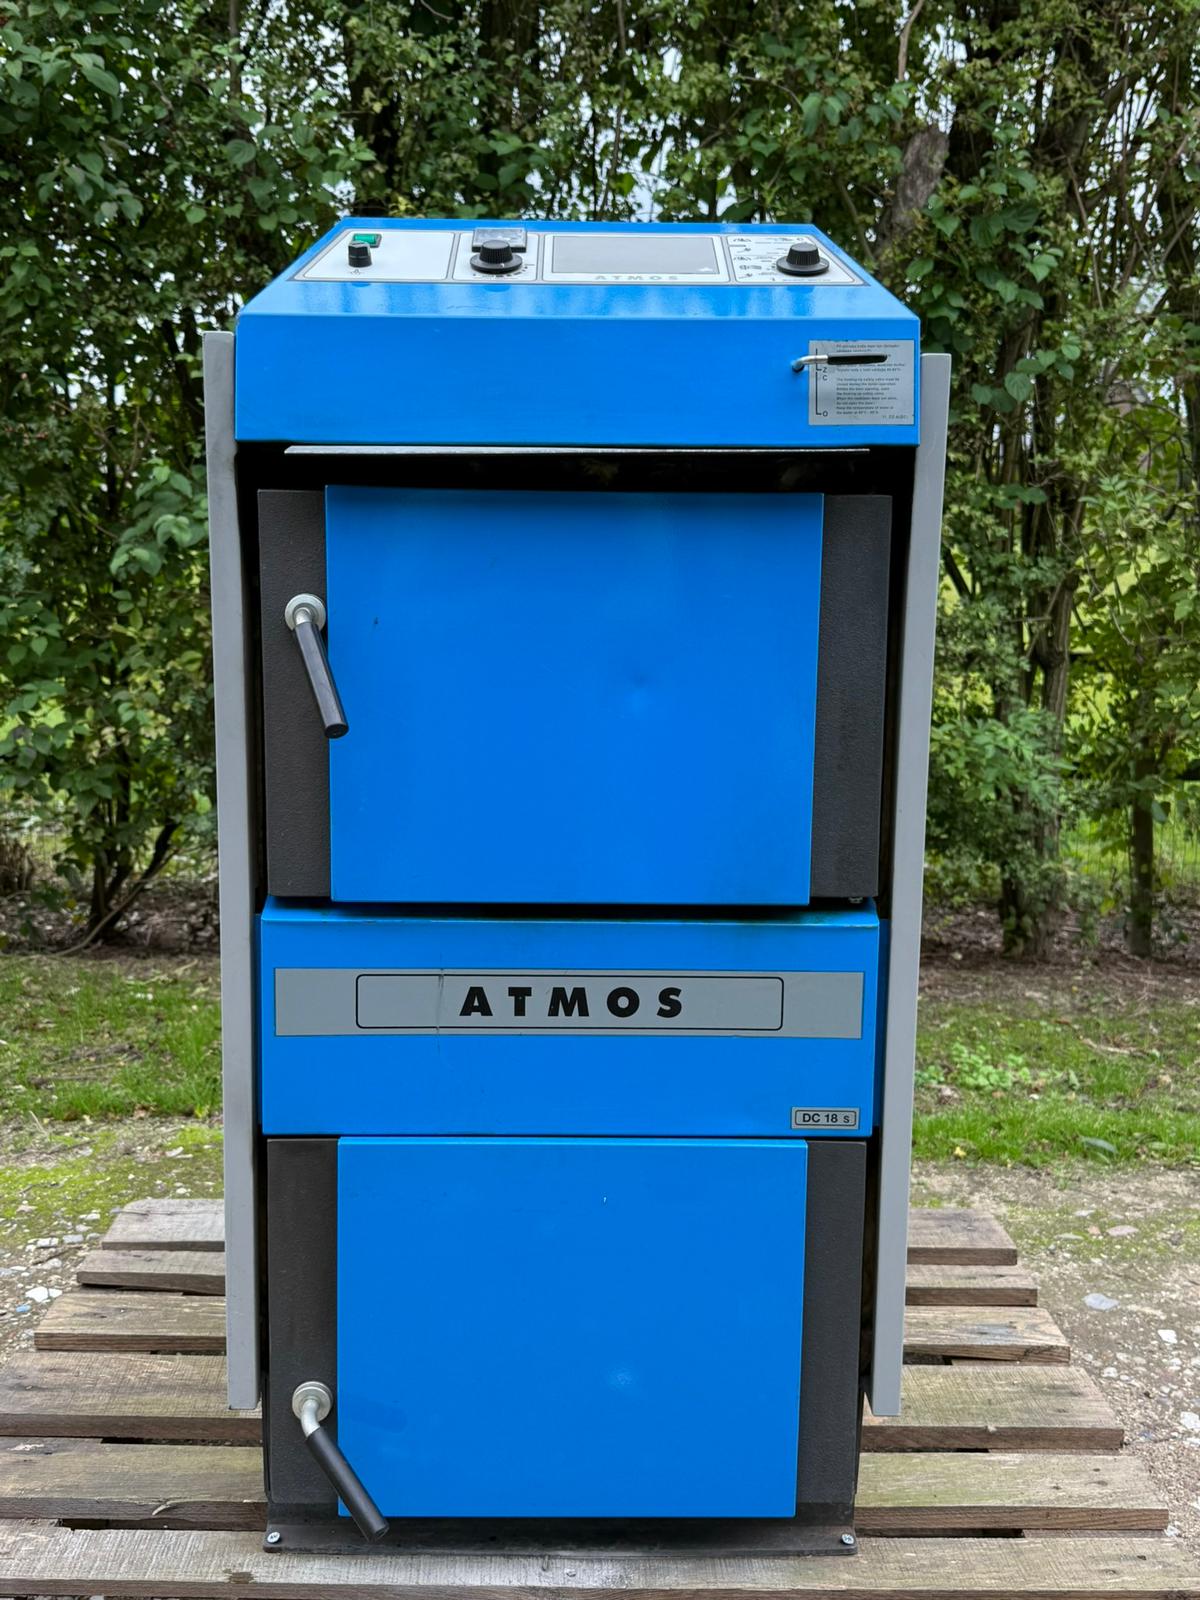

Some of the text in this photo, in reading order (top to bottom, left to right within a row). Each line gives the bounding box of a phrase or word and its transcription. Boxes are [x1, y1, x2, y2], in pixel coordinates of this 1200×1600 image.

[459, 986, 682, 1018] ATMOS
[802, 1112, 821, 1123] DC
[824, 1113, 838, 1123] 18
